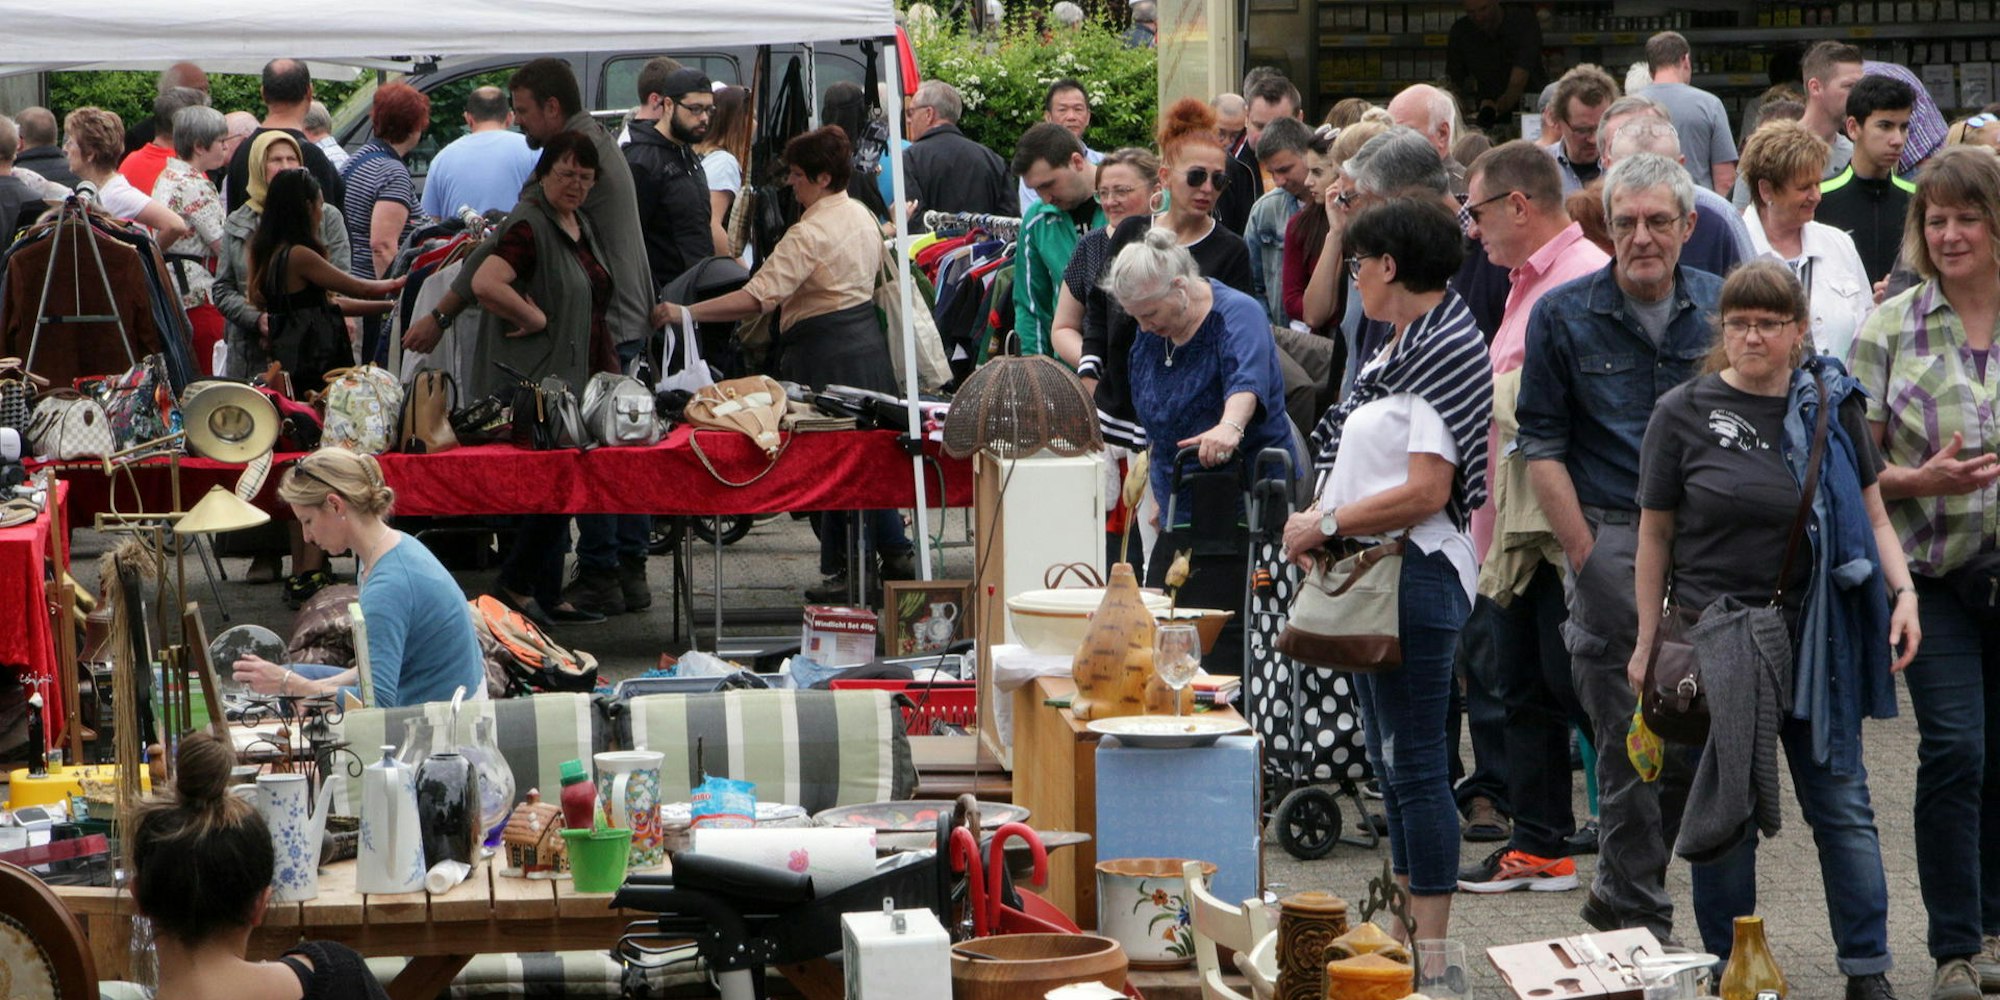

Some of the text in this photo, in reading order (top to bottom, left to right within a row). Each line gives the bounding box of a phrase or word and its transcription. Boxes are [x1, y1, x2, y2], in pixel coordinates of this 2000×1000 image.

[814, 620, 846, 629] Windlicht
[847, 622, 859, 630] Set
[691, 793, 711, 802] RIBO
